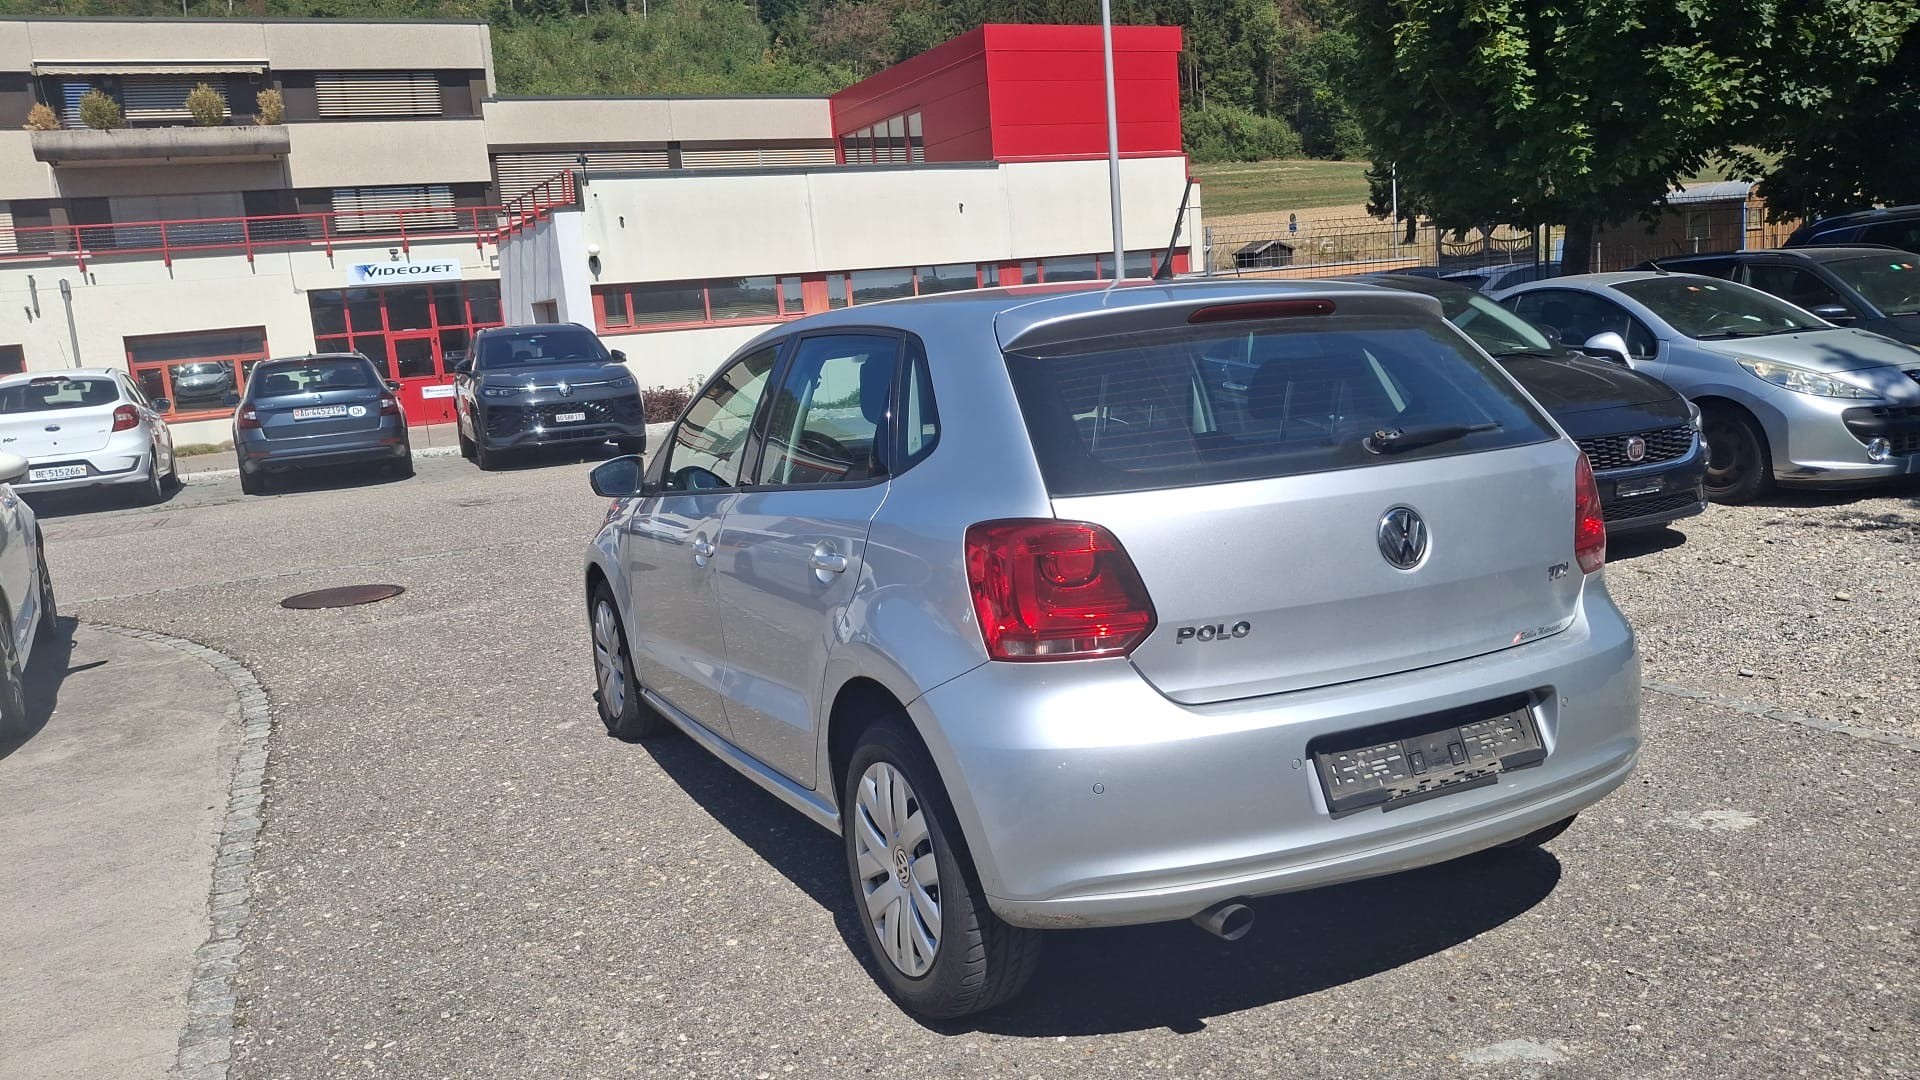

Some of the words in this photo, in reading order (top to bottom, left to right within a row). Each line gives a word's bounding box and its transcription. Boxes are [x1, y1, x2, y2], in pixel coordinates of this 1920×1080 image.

[366, 264, 453, 278] VIDEOJET
[352, 407, 363, 416] CH
[1548, 561, 1569, 582] TDI
[1176, 620, 1251, 645] POLO
